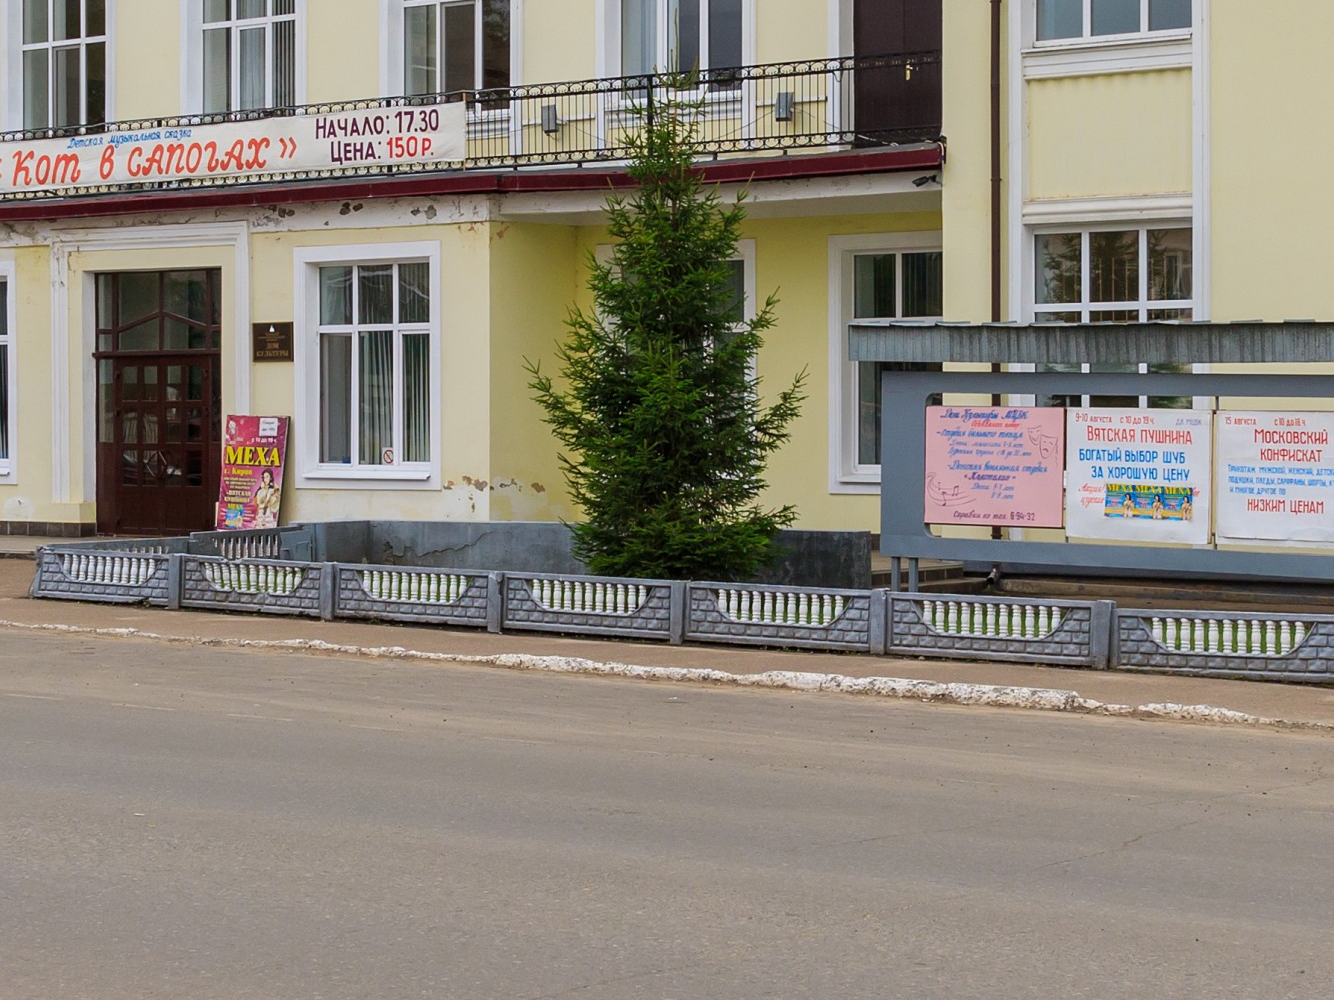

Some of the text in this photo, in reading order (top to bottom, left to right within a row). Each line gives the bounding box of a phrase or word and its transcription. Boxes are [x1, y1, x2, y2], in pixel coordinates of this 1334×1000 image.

[394, 108, 439, 133] 17.30
[67, 128, 193, 149] Детская музыкальная сказка
[330, 140, 382, 165] ЦЕНА:
[99, 144, 115, 180] в
[1140, 429, 1193, 445] ПУШНИНА
[224, 445, 281, 466] МЕХА
[1079, 447, 1186, 464] БОГАТЫЙ ВЫБОР ШУБ
[1260, 448, 1323, 462] КОНФИСКАТ
[1091, 465, 1190, 482] ЗА ХОРОШУЮ ЦЕНУ
[1106, 483, 1133, 493] МЕХА
[1135, 484, 1162, 494] МЕХА
[1164, 486, 1192, 495] МЕХА
[1256, 487, 1277, 495] ДРУГОЕ
[1247, 498, 1324, 515] НИЗКИМ ЦЕНАМ
